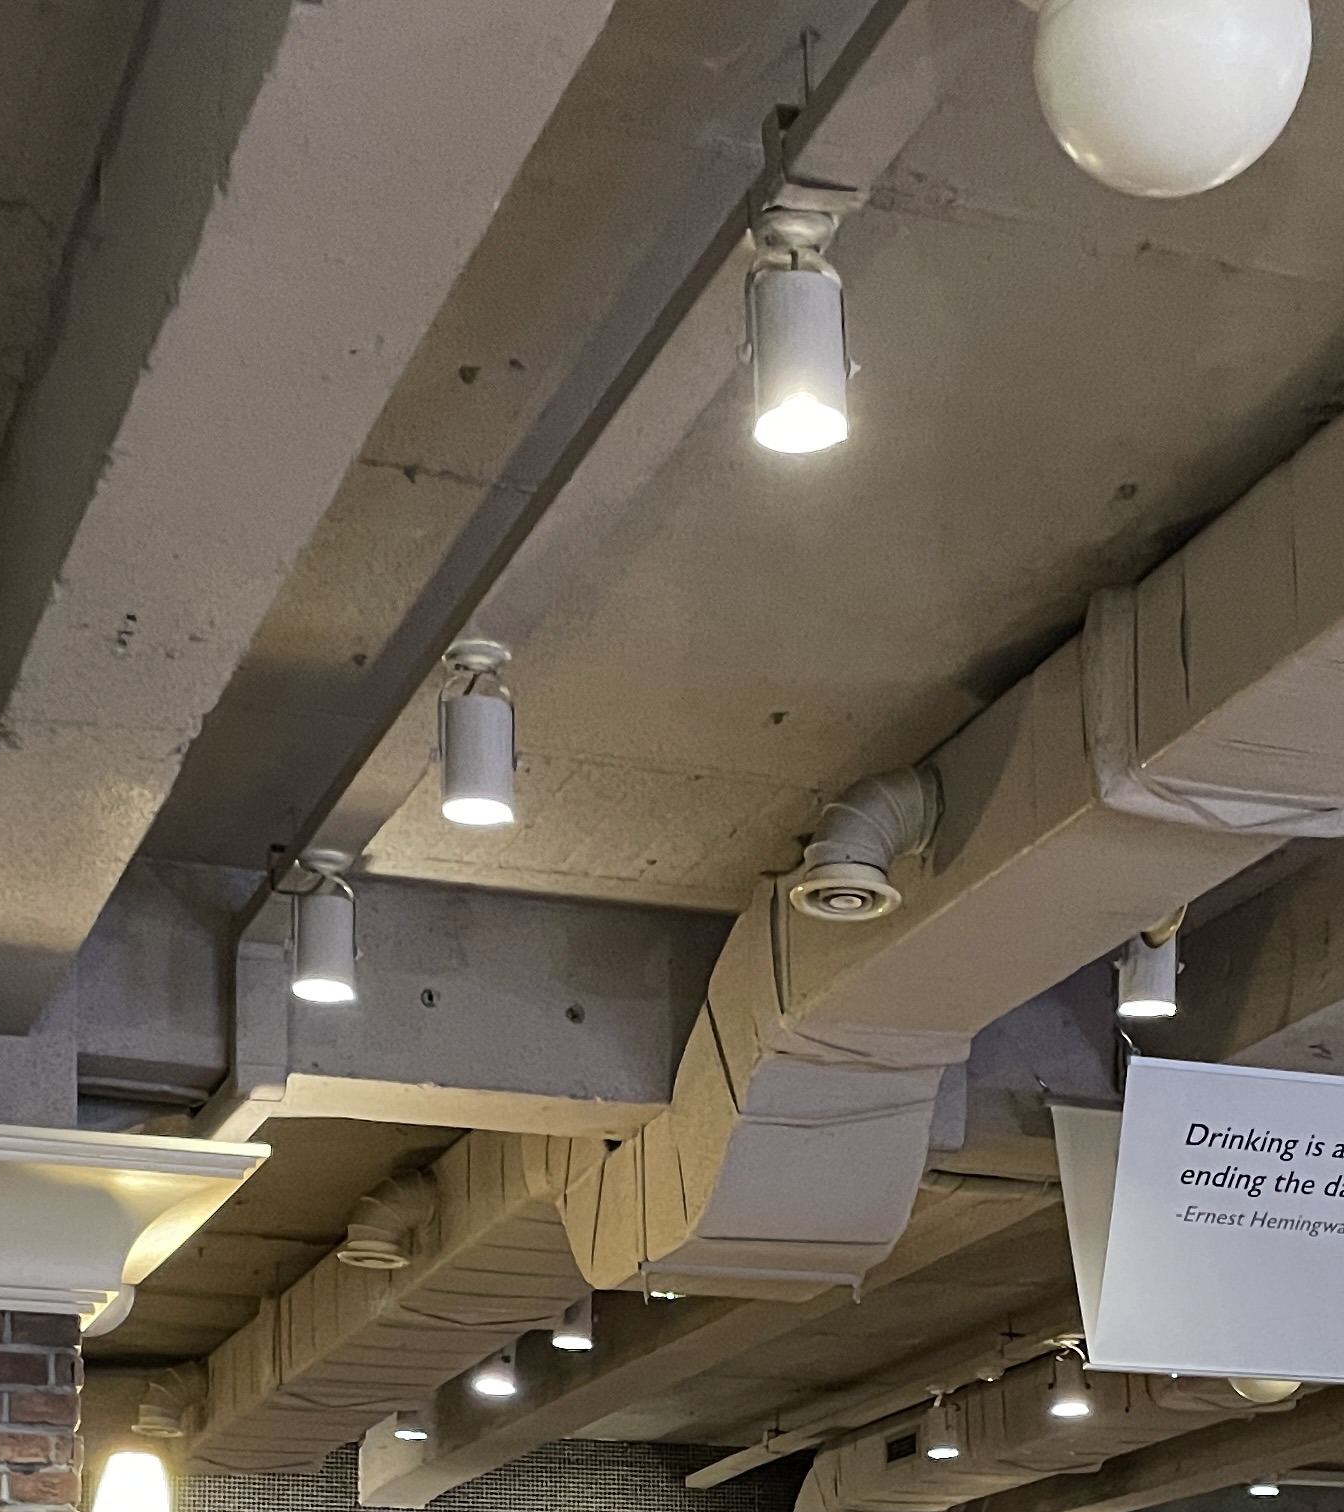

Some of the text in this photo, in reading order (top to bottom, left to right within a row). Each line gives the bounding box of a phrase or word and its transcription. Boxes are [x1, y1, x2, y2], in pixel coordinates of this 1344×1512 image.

[1185, 1123, 1299, 1161] Drinking
[1304, 1134, 1325, 1156] is
[1180, 1165, 1267, 1197] ending
[1274, 1171, 1315, 1195] the
